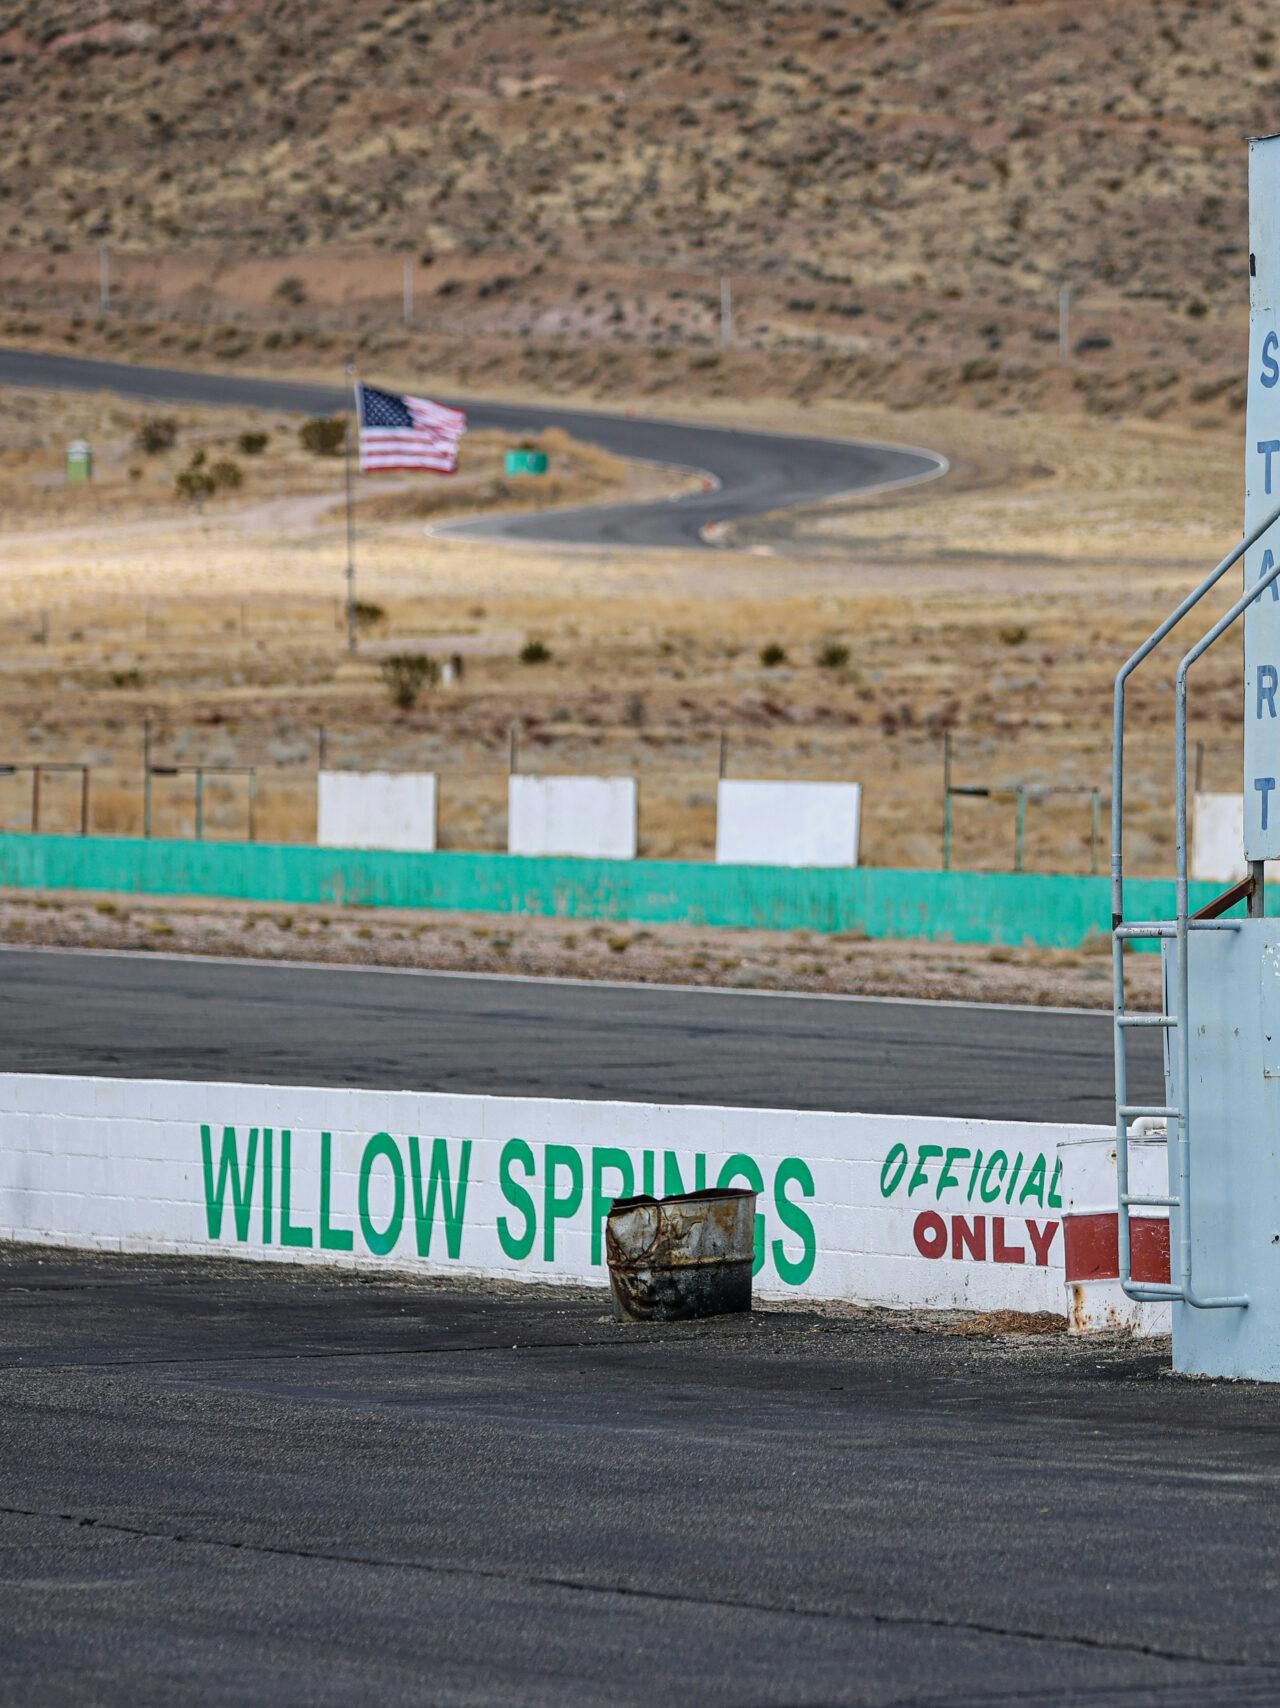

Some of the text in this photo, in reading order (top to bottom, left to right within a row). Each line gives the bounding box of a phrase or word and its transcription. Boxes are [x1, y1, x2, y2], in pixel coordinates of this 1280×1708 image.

[1254, 330, 1280, 831] START
[200, 1124, 472, 1259] WILLOW
[913, 1210, 1060, 1266] ONLY
